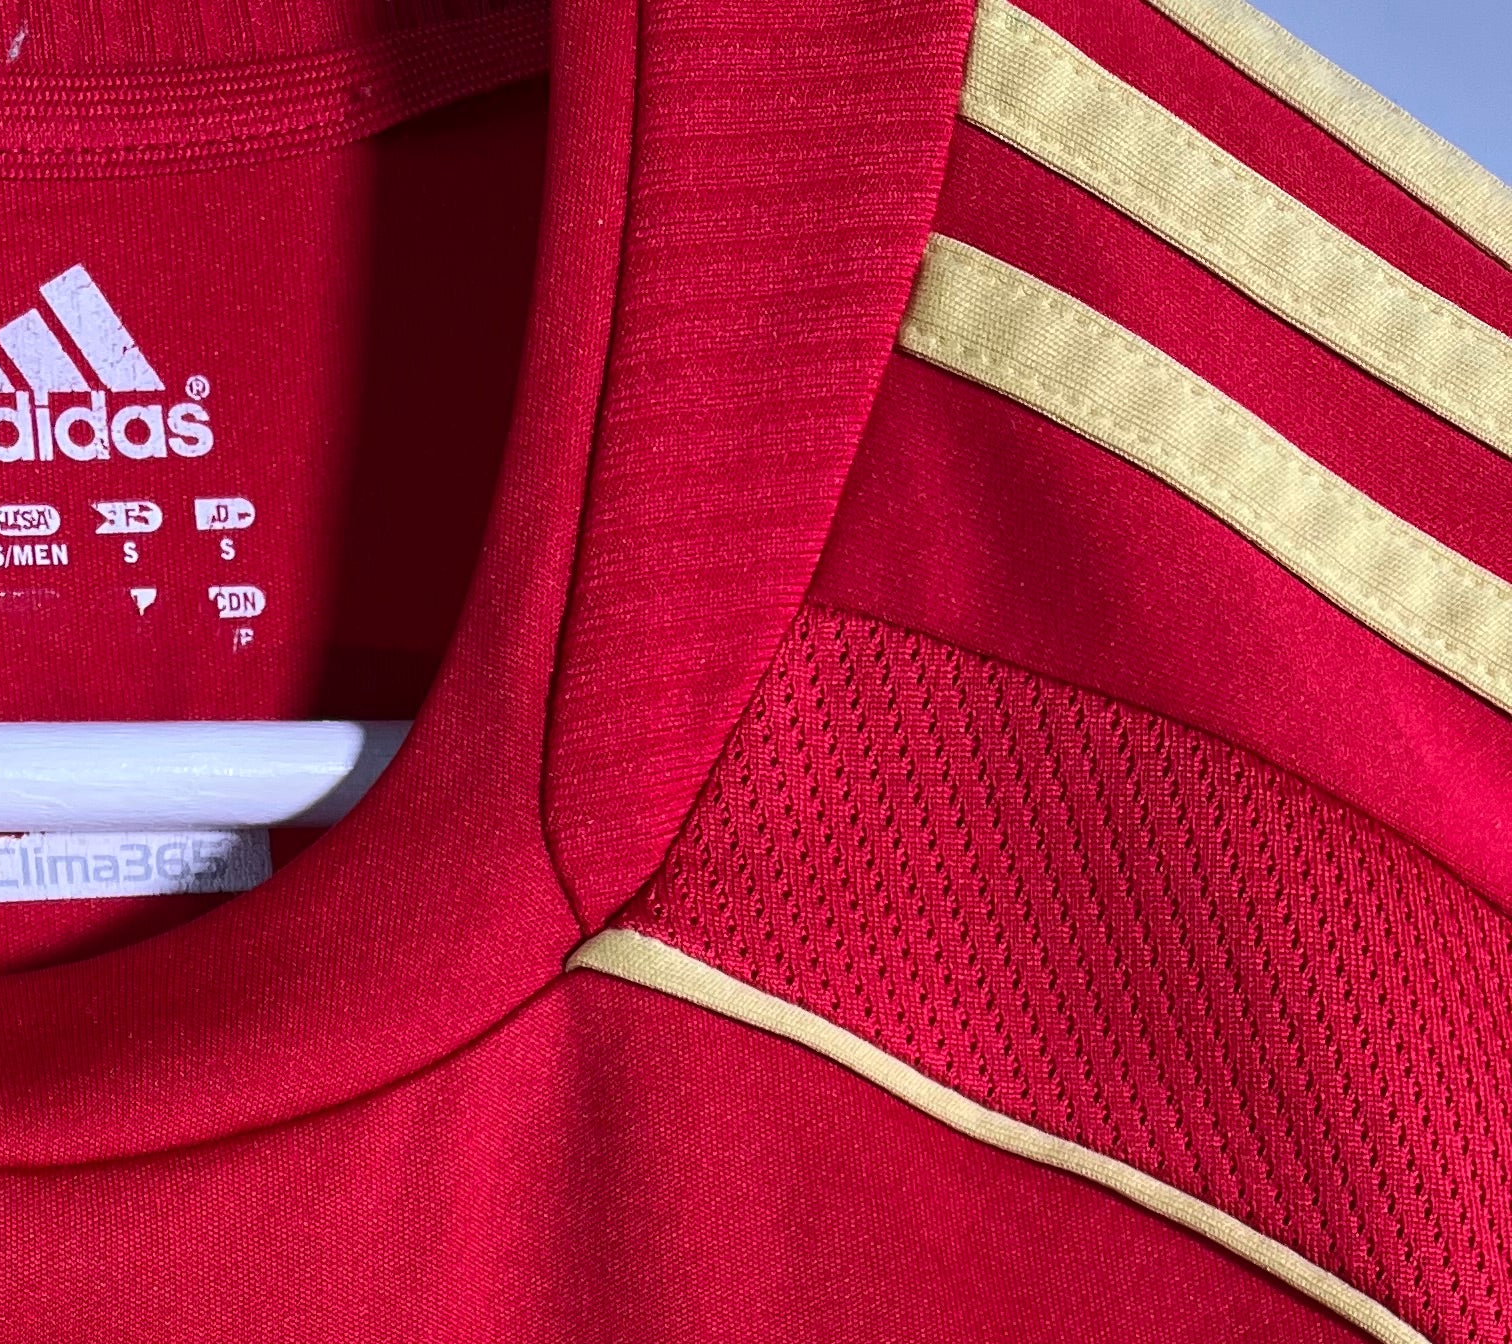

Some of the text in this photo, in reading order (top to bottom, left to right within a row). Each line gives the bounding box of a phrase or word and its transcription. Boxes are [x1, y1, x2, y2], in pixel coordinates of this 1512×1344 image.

[123, 541, 139, 564] S
[220, 538, 236, 561] S
[214, 592, 257, 612] CDN
